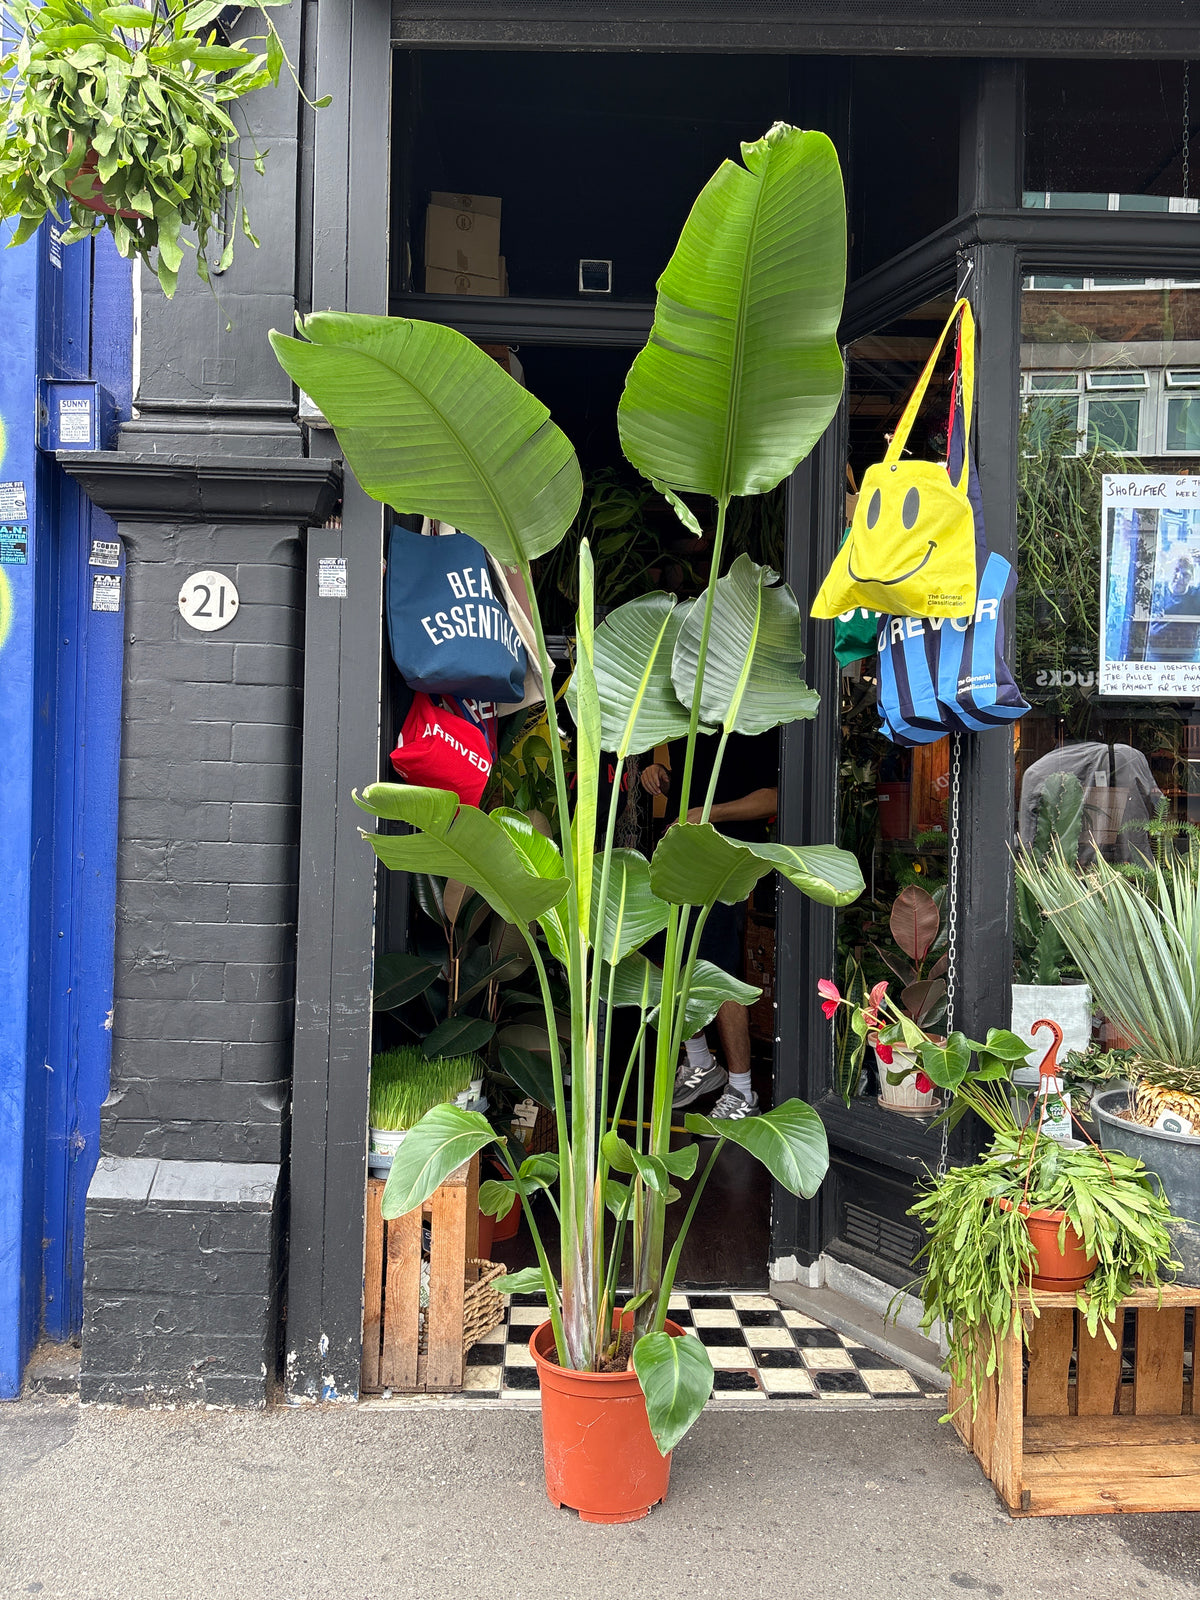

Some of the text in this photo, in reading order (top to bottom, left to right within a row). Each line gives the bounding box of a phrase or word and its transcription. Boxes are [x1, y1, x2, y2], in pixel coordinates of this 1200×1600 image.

[62, 400, 88, 408] SUNNY
[1176, 478, 1187, 487] OF
[1106, 482, 1167, 498] SHOPLIFTER
[1175, 490, 1198, 498] WEEK
[96, 542, 119, 550] COBRA
[94, 574, 121, 582] TAJ
[446, 567, 499, 603] BEA
[192, 584, 225, 617] 21
[421, 603, 522, 663] ESSENTIALS
[1105, 663, 1129, 671] SHE'S
[965, 673, 991, 683] General
[1104, 673, 1121, 681] THE
[1126, 673, 1153, 681] POLICE
[1161, 673, 1176, 681] ARE
[1104, 683, 1118, 691] THE
[1121, 683, 1153, 692] PAYMENT
[1172, 684, 1187, 692] THE
[421, 722, 493, 778] ARRIVED
